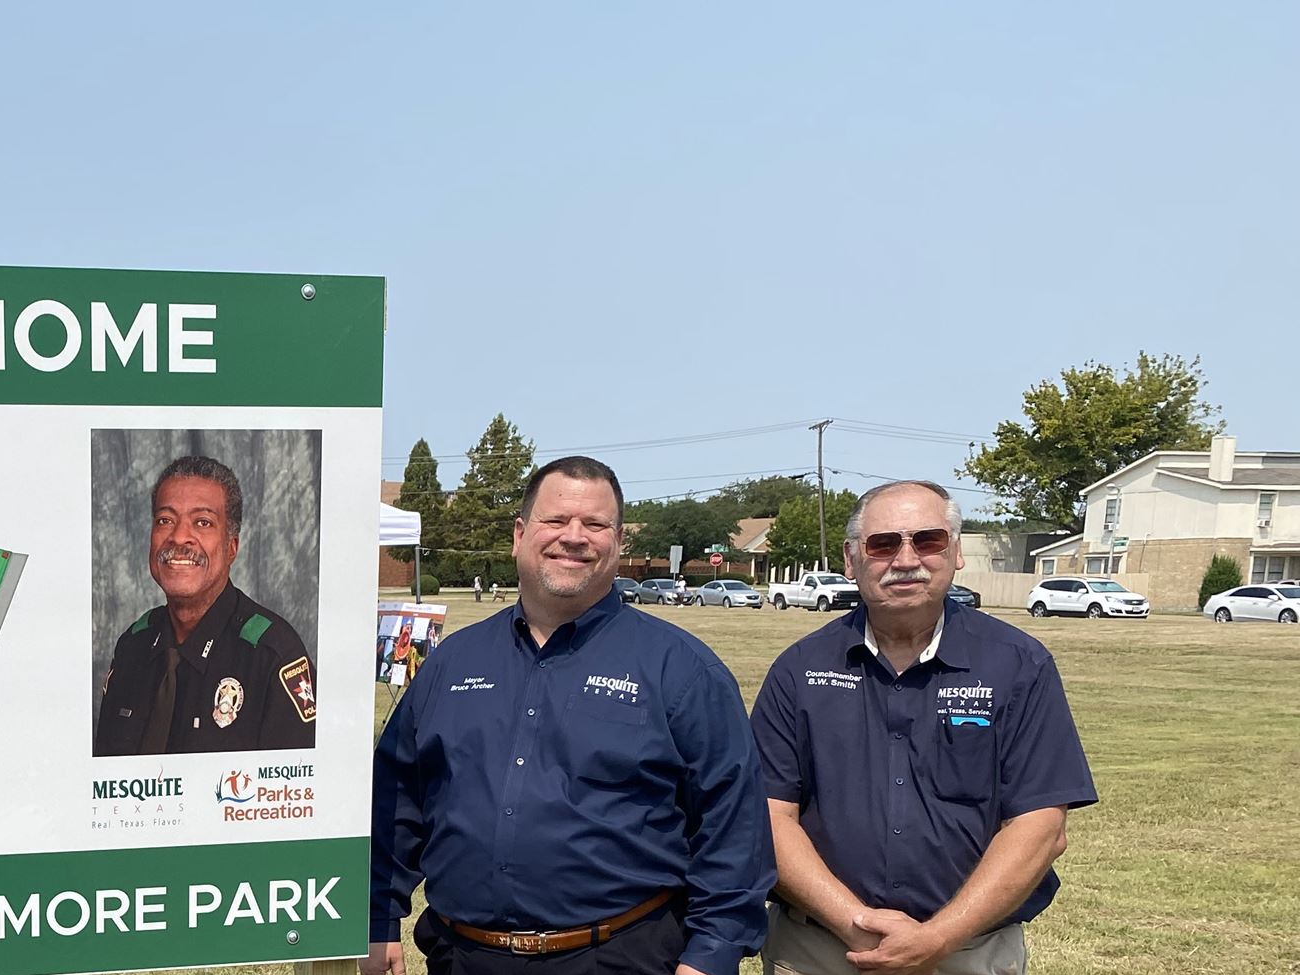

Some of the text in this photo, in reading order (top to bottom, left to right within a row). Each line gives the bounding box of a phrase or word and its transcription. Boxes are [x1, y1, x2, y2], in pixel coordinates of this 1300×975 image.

[805, 670, 862, 681] Councilmember
[807, 677, 857, 690] B.W. Smith
[583, 686, 637, 703] TEXAS
[937, 699, 993, 707] EXAS
[304, 705, 316, 717] POL
[257, 784, 314, 803] Parks &
[92, 803, 184, 815] TEXAS
[224, 802, 313, 822] Recreation
[188, 876, 342, 928] PARK
